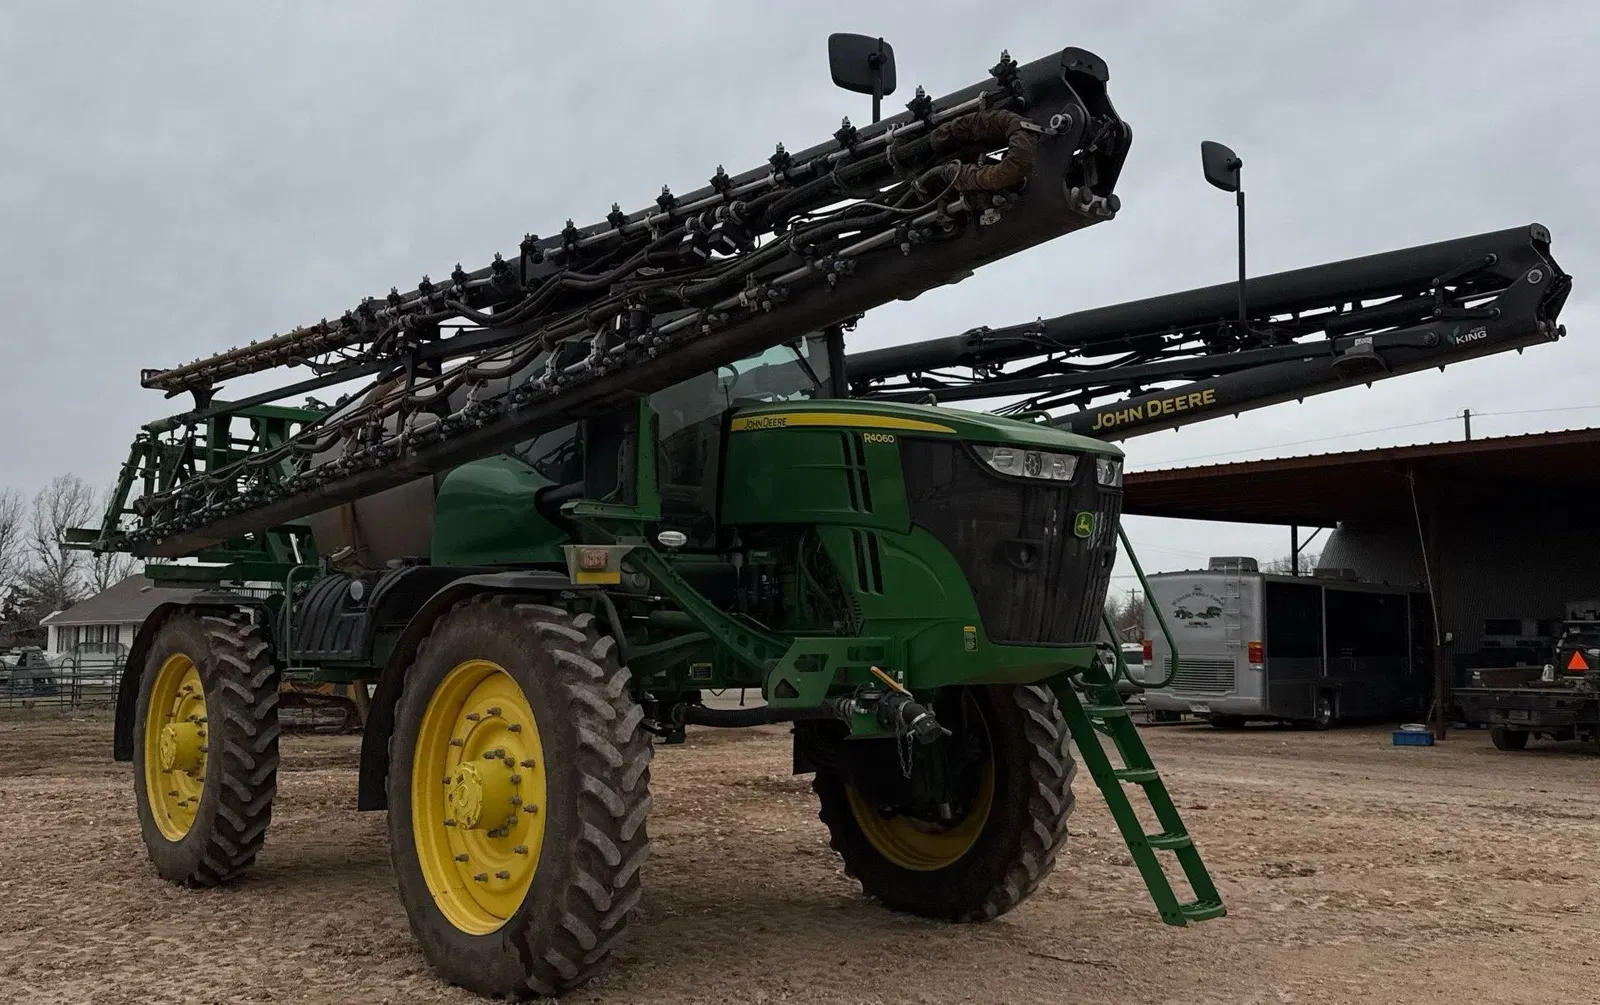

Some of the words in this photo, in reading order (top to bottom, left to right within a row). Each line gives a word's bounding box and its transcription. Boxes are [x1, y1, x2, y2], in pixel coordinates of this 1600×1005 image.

[1455, 330, 1487, 344] KING
[1092, 406, 1143, 430] JOHN
[1146, 389, 1216, 418] DEERE
[743, 418, 762, 429] JOHN
[763, 417, 787, 427] DEERE
[863, 432, 895, 443] R4060
